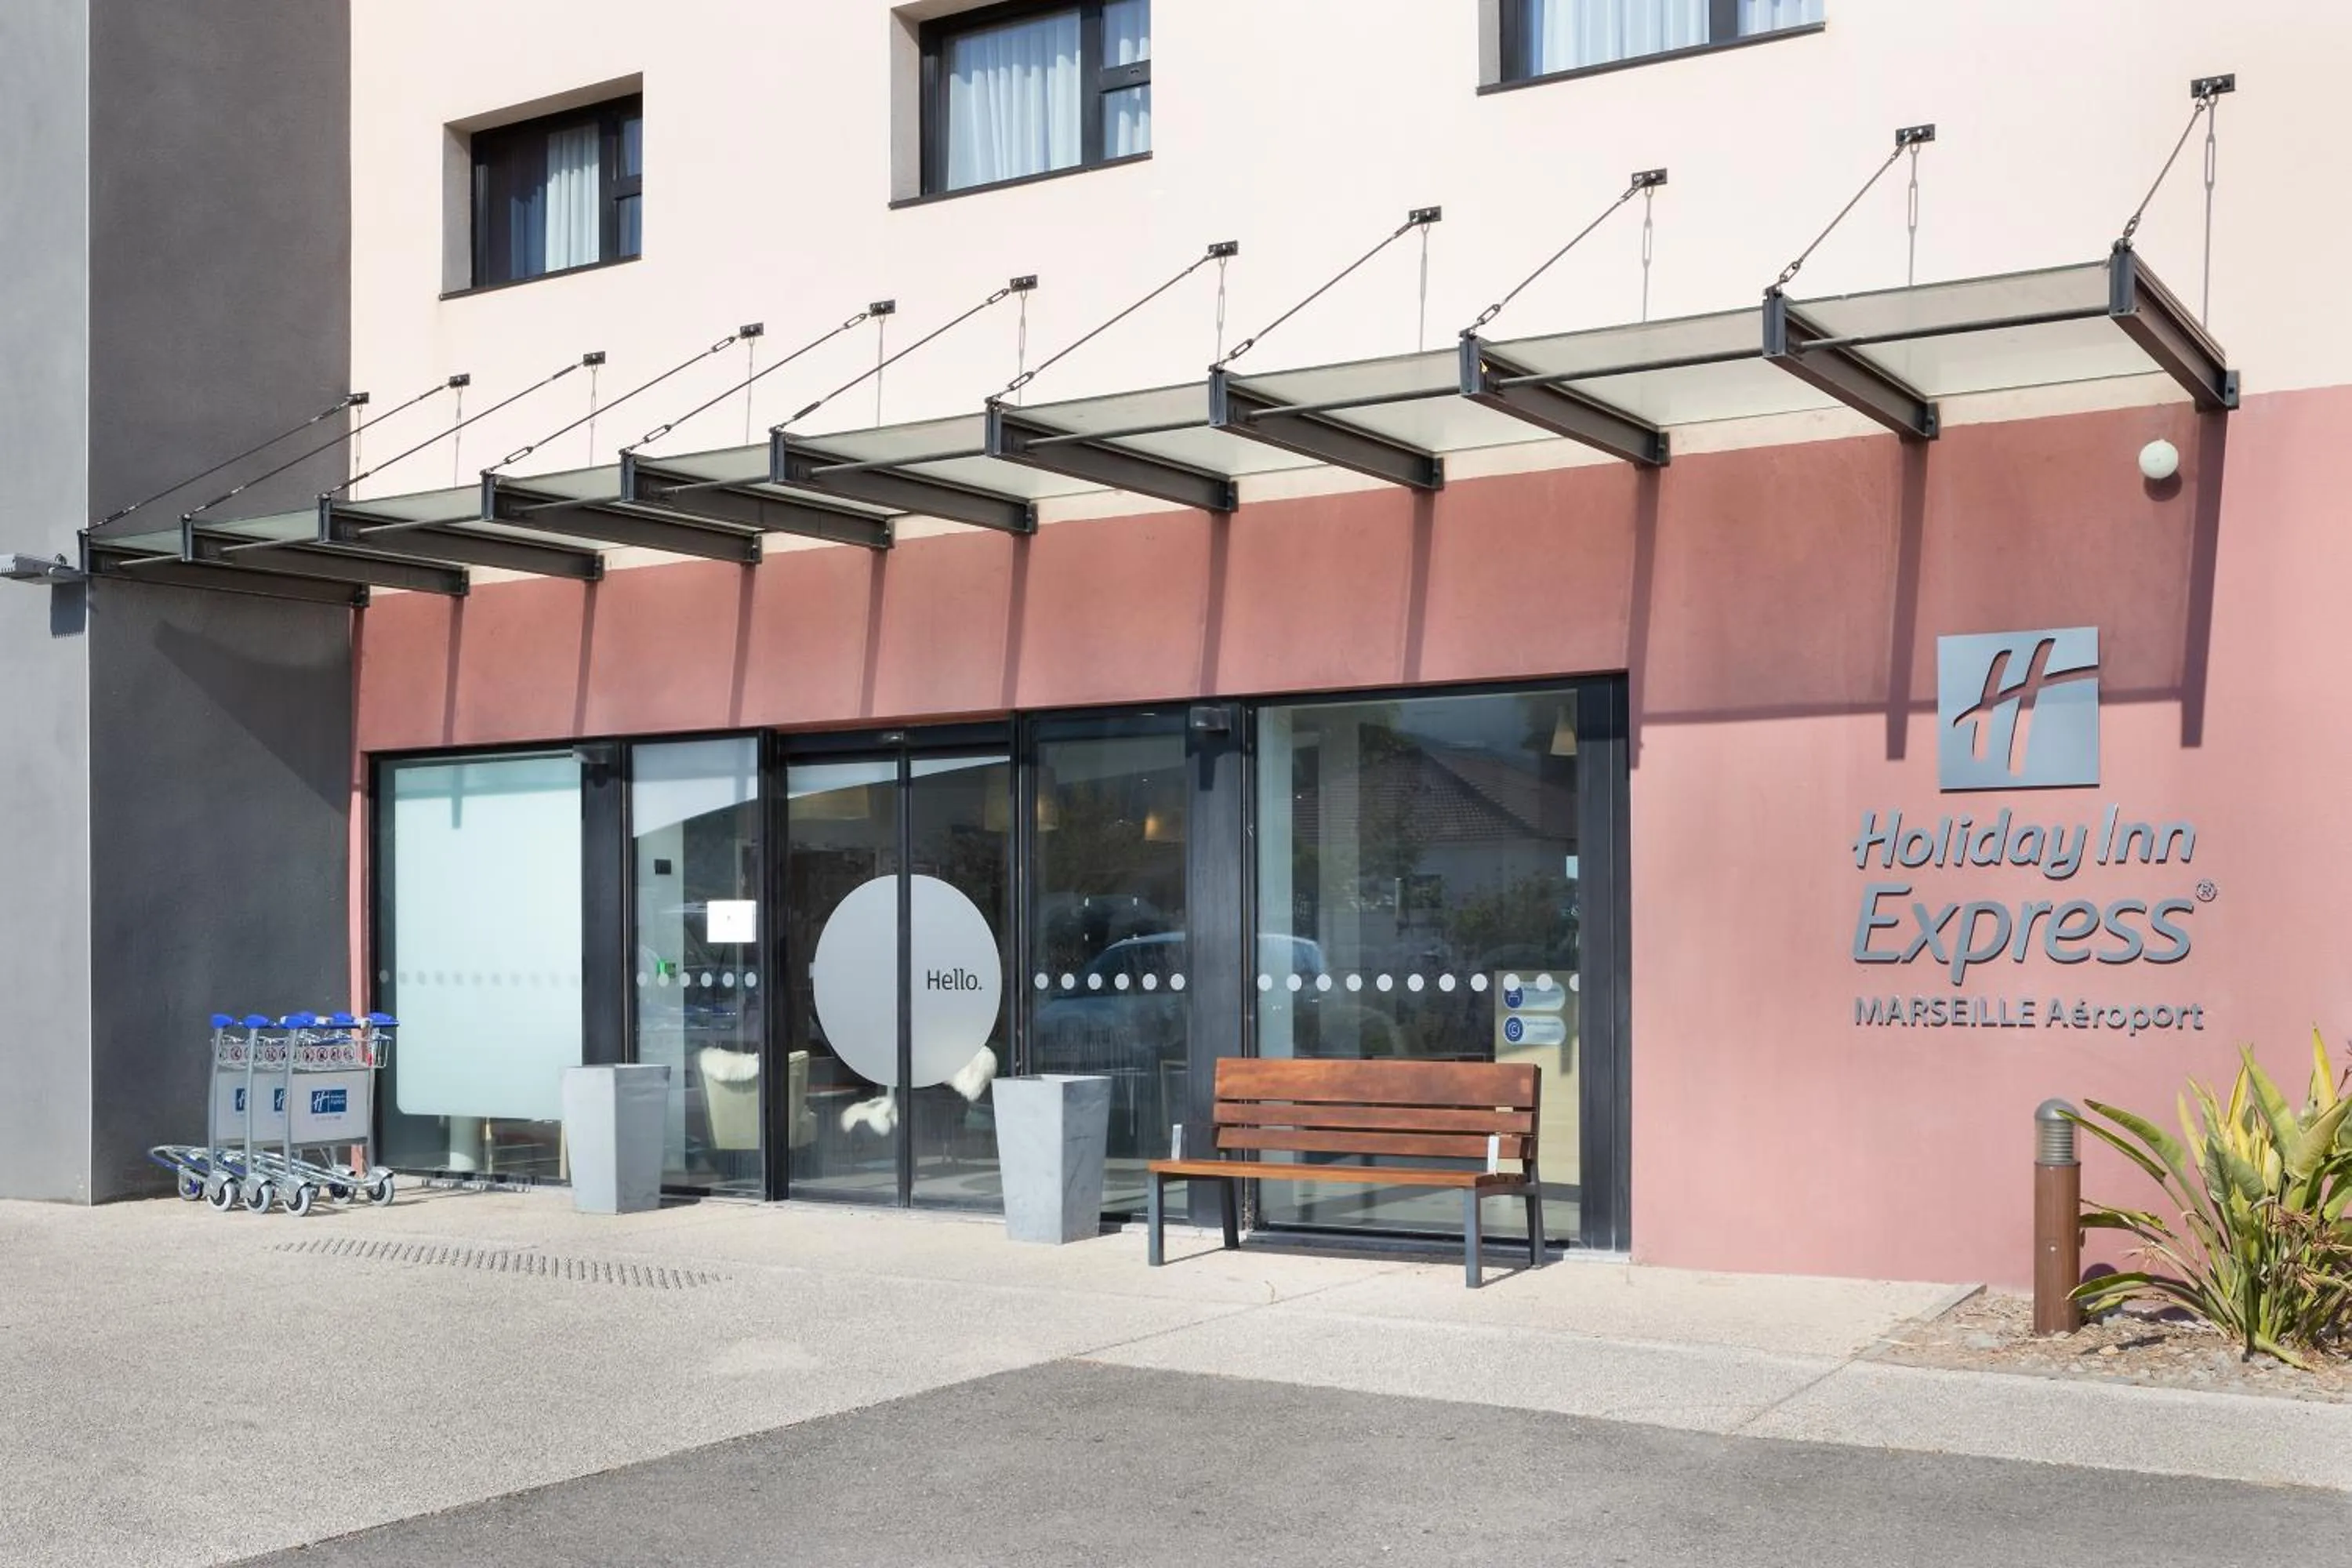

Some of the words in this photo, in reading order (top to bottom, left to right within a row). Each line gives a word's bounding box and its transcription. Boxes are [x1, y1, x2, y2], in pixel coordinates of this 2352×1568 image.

[1853, 808, 2088, 880] Holiday
[2096, 802, 2196, 866] Inn
[927, 967, 982, 990] Hello.
[1854, 996, 2037, 1028] MARSEILLE
[2045, 998, 2205, 1036] Aéroport
